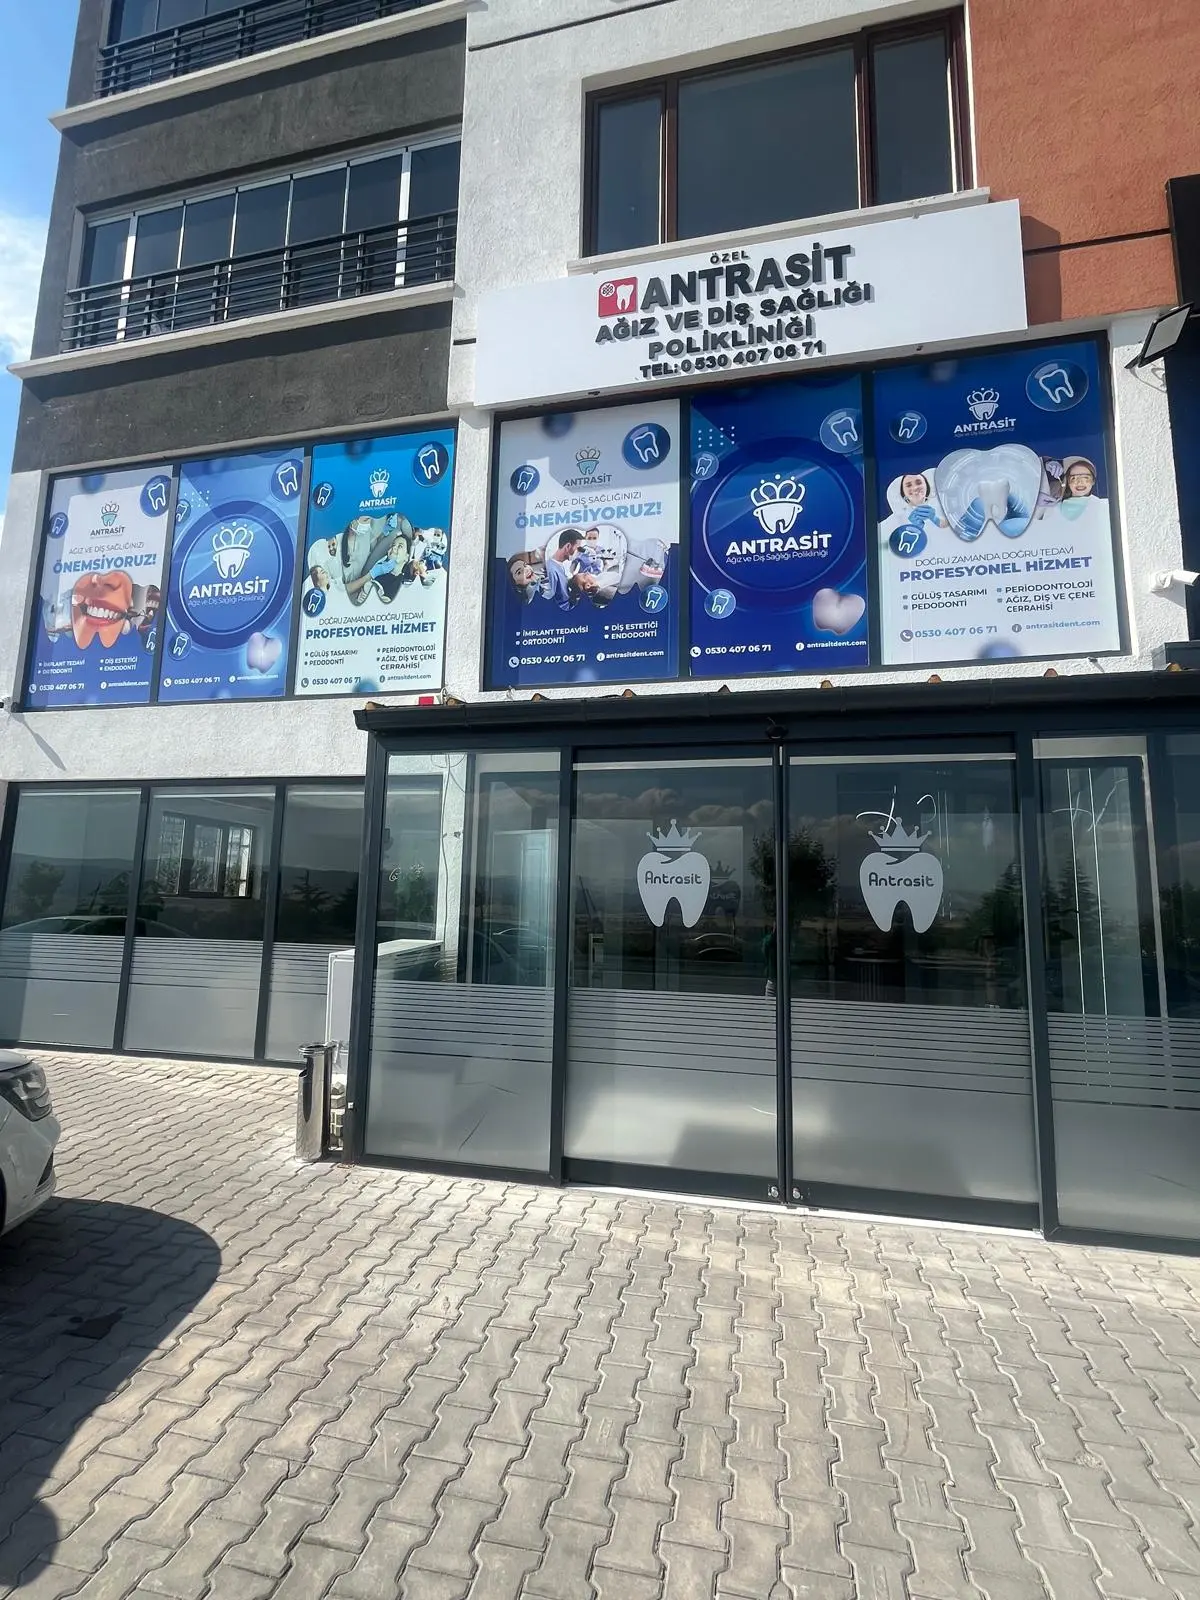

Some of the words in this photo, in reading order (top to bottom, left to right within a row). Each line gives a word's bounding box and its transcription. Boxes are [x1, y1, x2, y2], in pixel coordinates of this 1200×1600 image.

[709, 250, 749, 264] ÖZEL
[640, 242, 855, 313] ANTRASİT
[595, 317, 658, 343] AĞIZ
[665, 310, 701, 331] VE
[708, 300, 752, 326] DİŞ
[760, 280, 873, 317] SAĞLIĞI
[648, 314, 813, 359] POLİKLİNİĞİ
[733, 348, 769, 365] 407
[773, 344, 797, 359] 06
[802, 340, 824, 355] 71
[954, 417, 1016, 433] ANTRASİT
[563, 473, 612, 487] ANTRASİT
[359, 496, 397, 508] ANTRASİT
[535, 500, 555, 509] AĞIZ
[557, 499, 569, 507] VE
[515, 502, 662, 529] ÖNEMSİYORUZ!
[90, 525, 126, 537] ANTRASİT
[725, 530, 832, 556] ANTRASİT
[53, 553, 157, 574] ÖNEMSİYORUZ!
[915, 557, 951, 567] DOĞRU
[952, 553, 1000, 564] ZAMANDA
[1002, 550, 1038, 560] DOĞRU
[900, 562, 1021, 582] PROFESYONEL
[1026, 556, 1092, 572] HİZMET
[189, 576, 269, 599] ANTRASİT
[1005, 579, 1093, 593] PERİODONTOLOJİ
[911, 591, 942, 601] GÜLÜŞ
[944, 588, 987, 598] TASARIMI
[1033, 592, 1050, 602] DİŞ
[1052, 592, 1066, 600] VE
[1068, 590, 1096, 600] ÇENE
[911, 599, 967, 610] PEDODONTİ
[1006, 602, 1053, 613] CERRAHİSİ
[306, 625, 388, 639] PROFESYONEL
[391, 621, 436, 634] HİZMET
[611, 623, 624, 632] DİŞ
[625, 621, 658, 630] ESTETİĞİ
[1025, 619, 1100, 630] antrasitdent.com
[522, 629, 554, 637] İMPLANT
[611, 630, 657, 640] ENDODONTİ
[915, 628, 942, 638] 0530
[944, 627, 966, 637] 407
[969, 626, 984, 636] 06
[986, 625, 998, 634] 71
[522, 636, 565, 646] ORTODONTİ
[806, 639, 867, 649] antrasitdent.com
[606, 649, 664, 659] antrasitdent.com
[705, 647, 727, 655] 0530
[729, 646, 746, 654] 407
[748, 645, 760, 653] 06
[762, 644, 771, 652] 71
[521, 656, 542, 665] 0530
[544, 655, 560, 664] 407
[563, 654, 575, 662] 06
[576, 654, 585, 662] 71
[330, 677, 344, 685] 407
[645, 870, 702, 885] Antrasit
[868, 872, 935, 888] Antrasit
